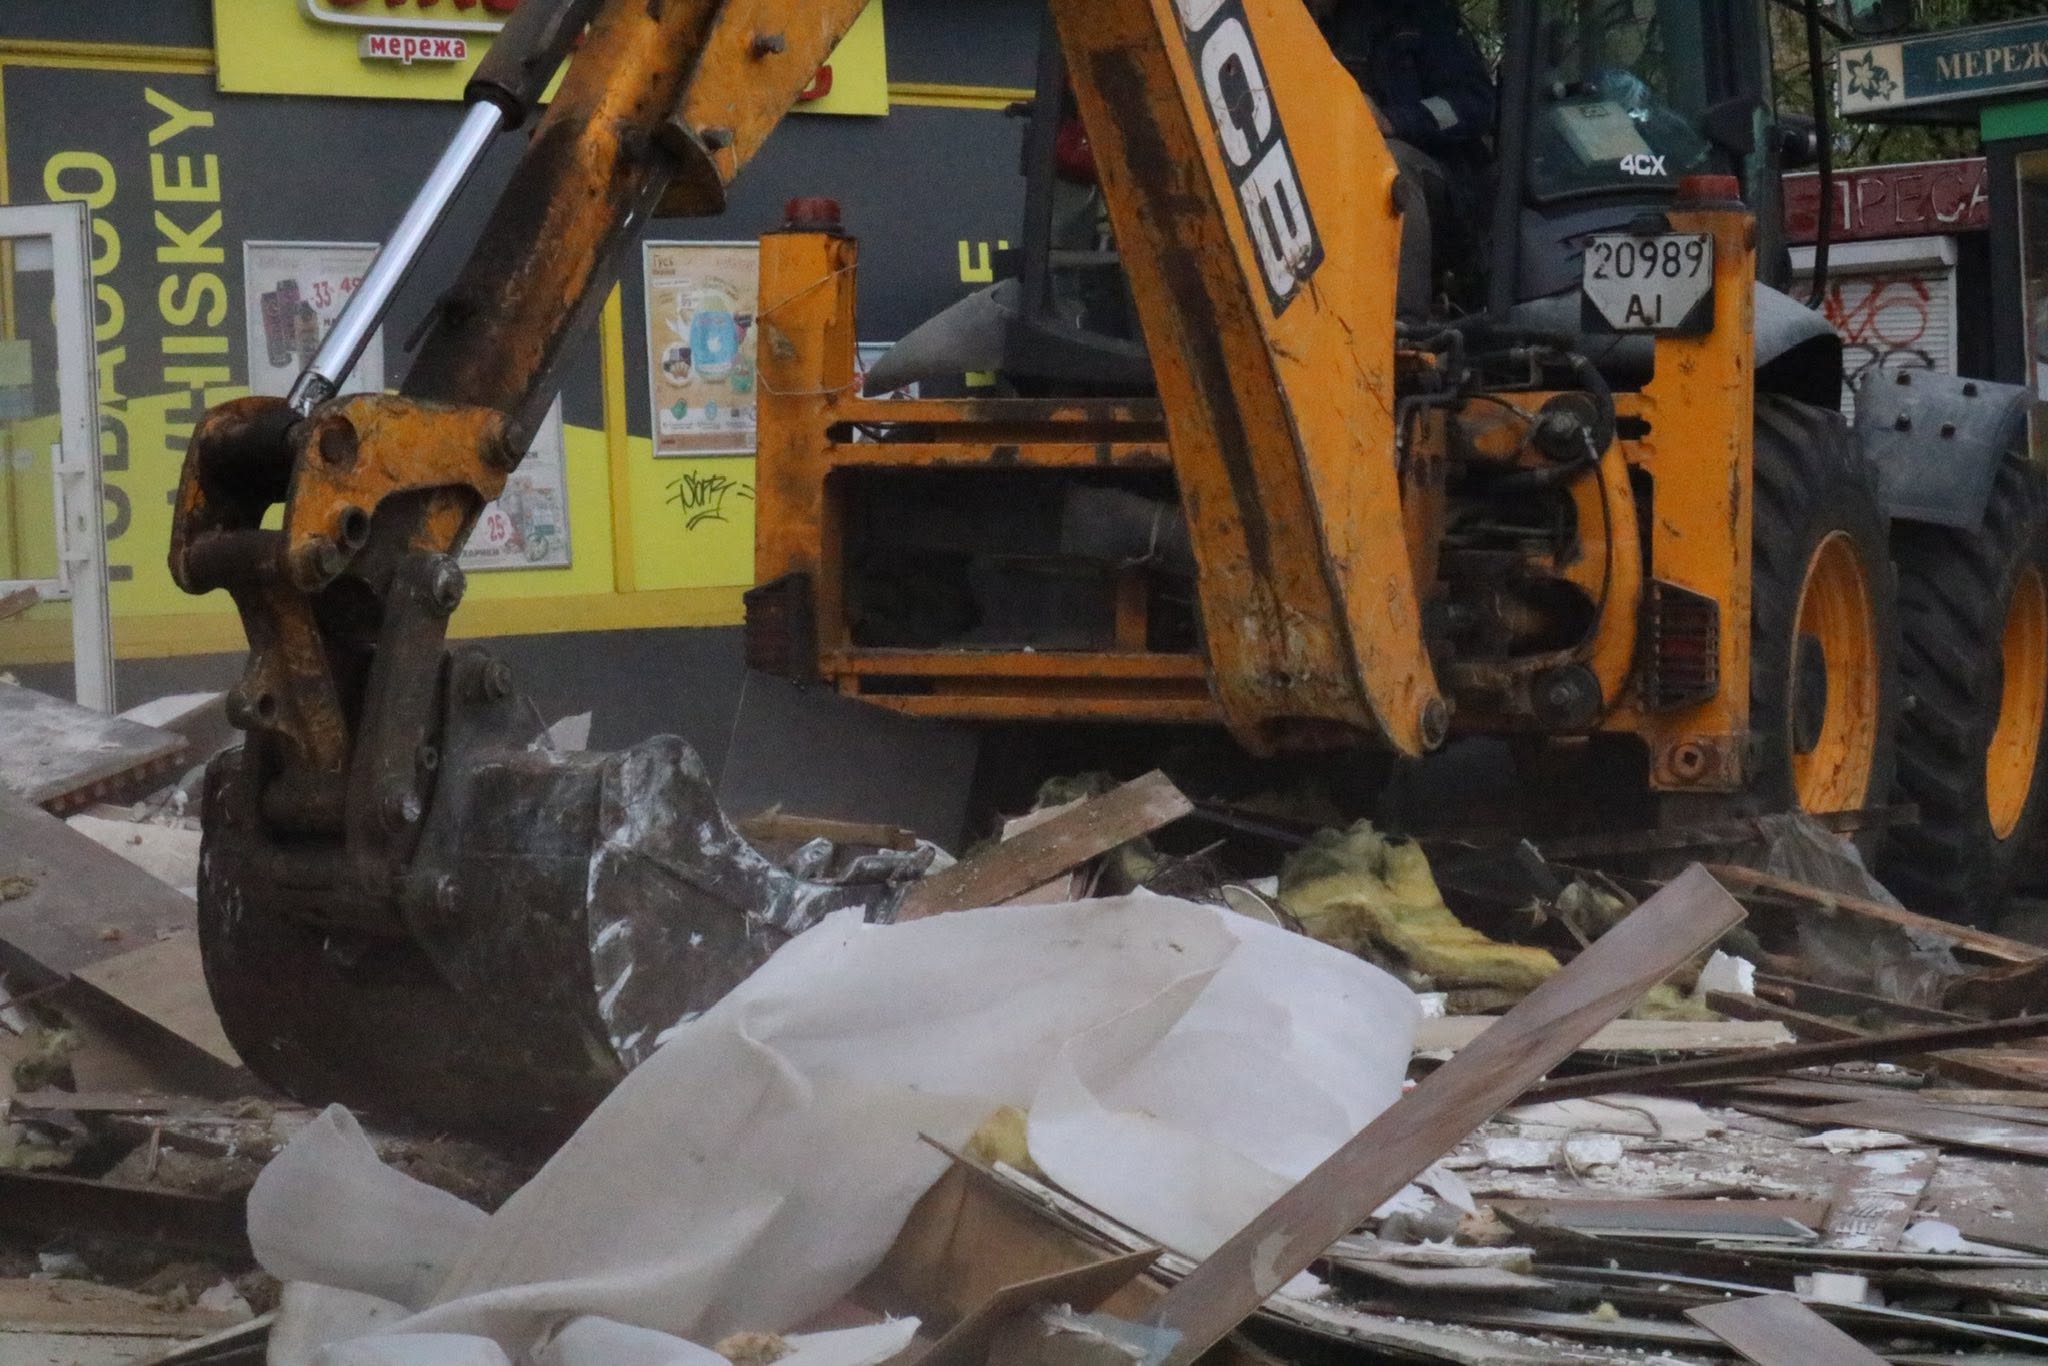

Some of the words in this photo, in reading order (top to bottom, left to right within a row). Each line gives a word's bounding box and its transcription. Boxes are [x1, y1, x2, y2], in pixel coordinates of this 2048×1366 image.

[370, 36, 466, 62] мережа
[1619, 153, 1668, 176] 4CX
[1592, 241, 1705, 279] 20989
